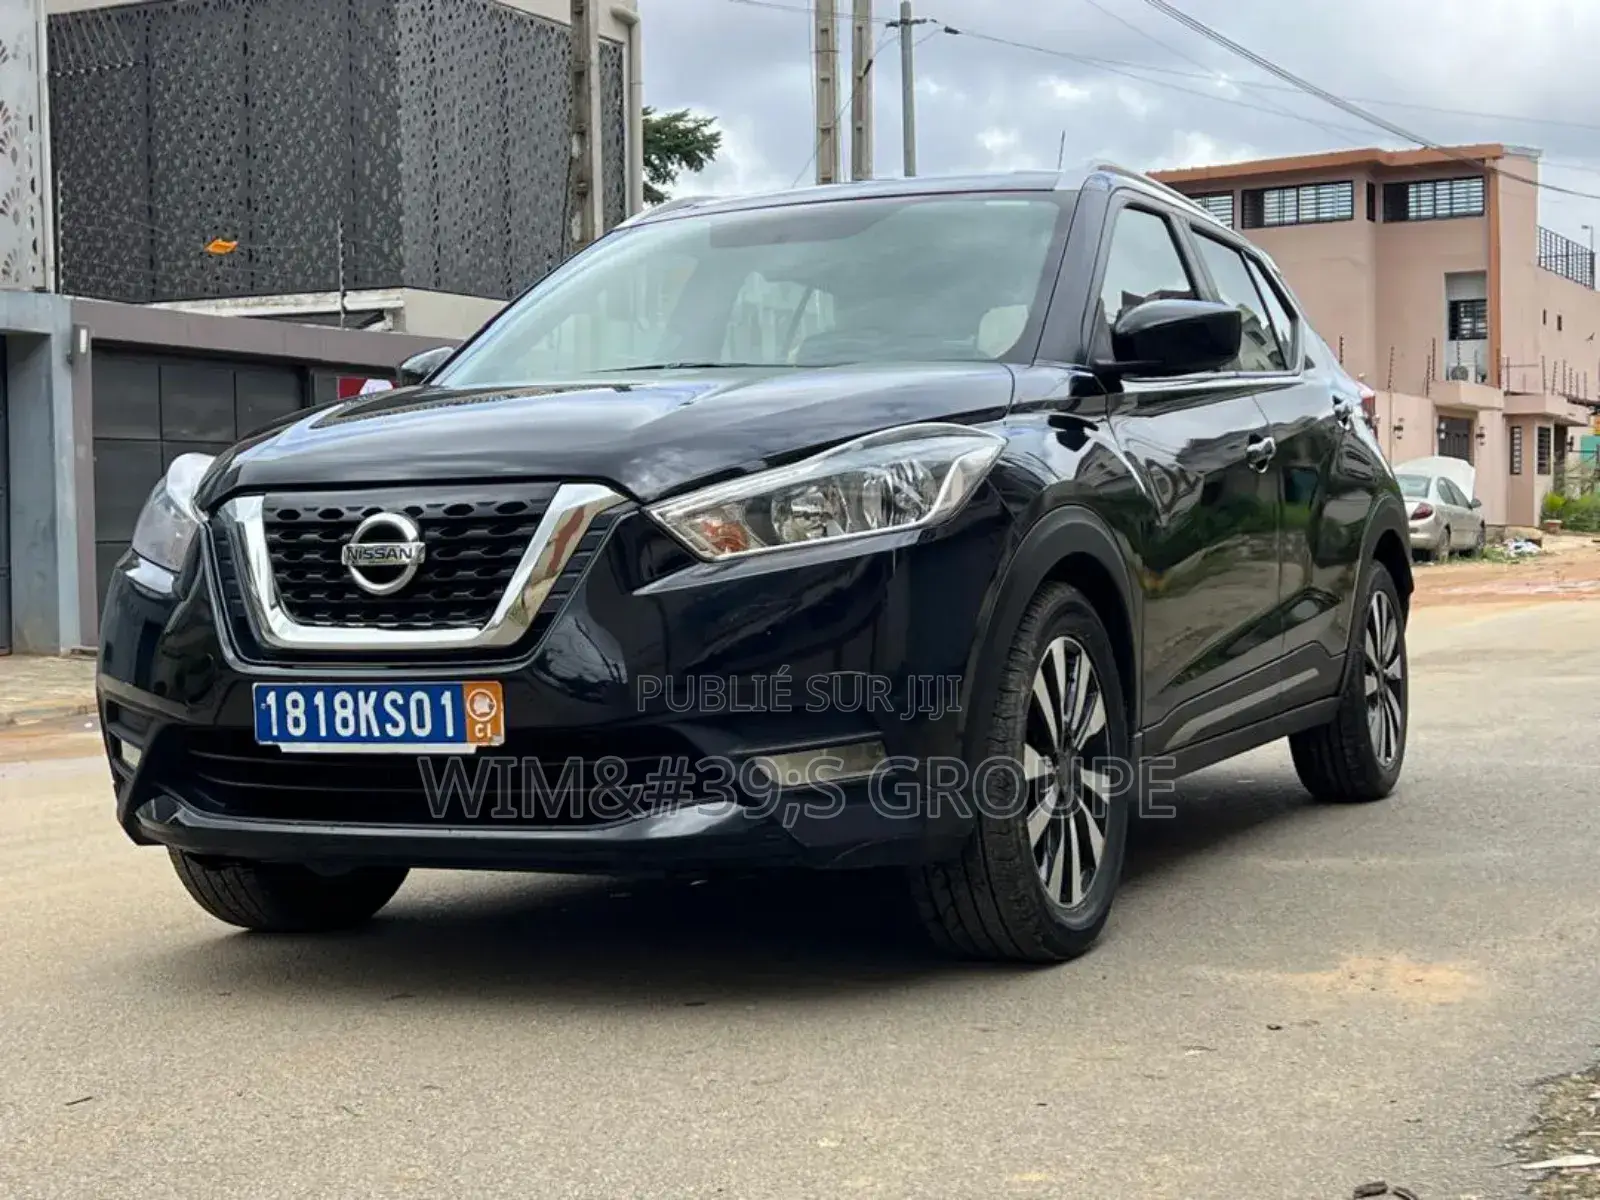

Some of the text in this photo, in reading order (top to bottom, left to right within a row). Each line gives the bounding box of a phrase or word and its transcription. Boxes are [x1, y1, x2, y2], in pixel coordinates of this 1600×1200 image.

[346, 546, 413, 561] NISSAN
[265, 691, 455, 737] 1818KS01
[474, 723, 492, 738] CI
